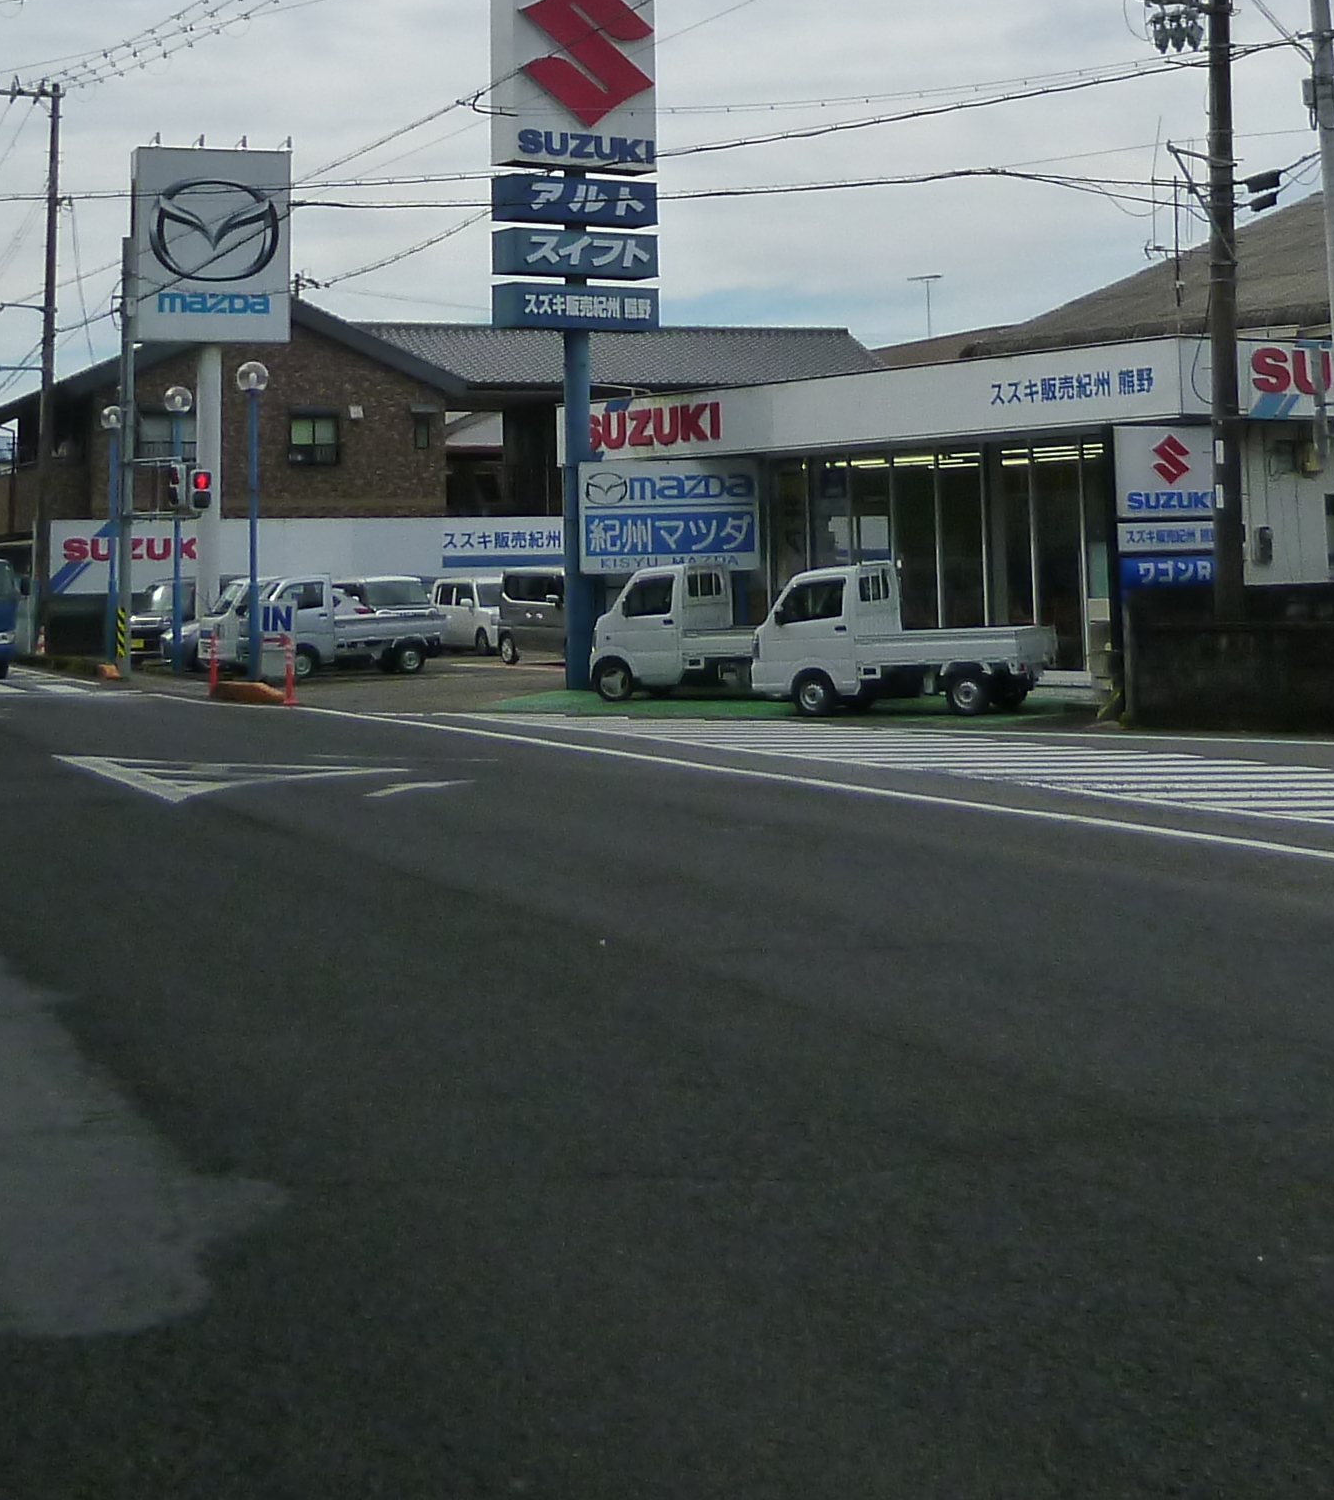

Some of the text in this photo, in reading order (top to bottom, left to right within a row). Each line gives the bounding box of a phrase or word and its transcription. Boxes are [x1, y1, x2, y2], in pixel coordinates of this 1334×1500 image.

[518, 128, 655, 165] SUZUKI
[531, 182, 646, 216] アルト
[526, 235, 650, 268] スイフト
[158, 292, 271, 314] mazda
[990, 367, 1154, 406] スズキ販売紀州 熊野
[629, 473, 755, 501] mazda
[442, 529, 562, 550] スズキ販売紀州
[589, 513, 753, 553] 紀州マツダ
[63, 537, 198, 562] SUUK
[600, 556, 659, 569] KISYU
[1138, 560, 1212, 584] ワゴンR
[262, 605, 292, 632] IN
